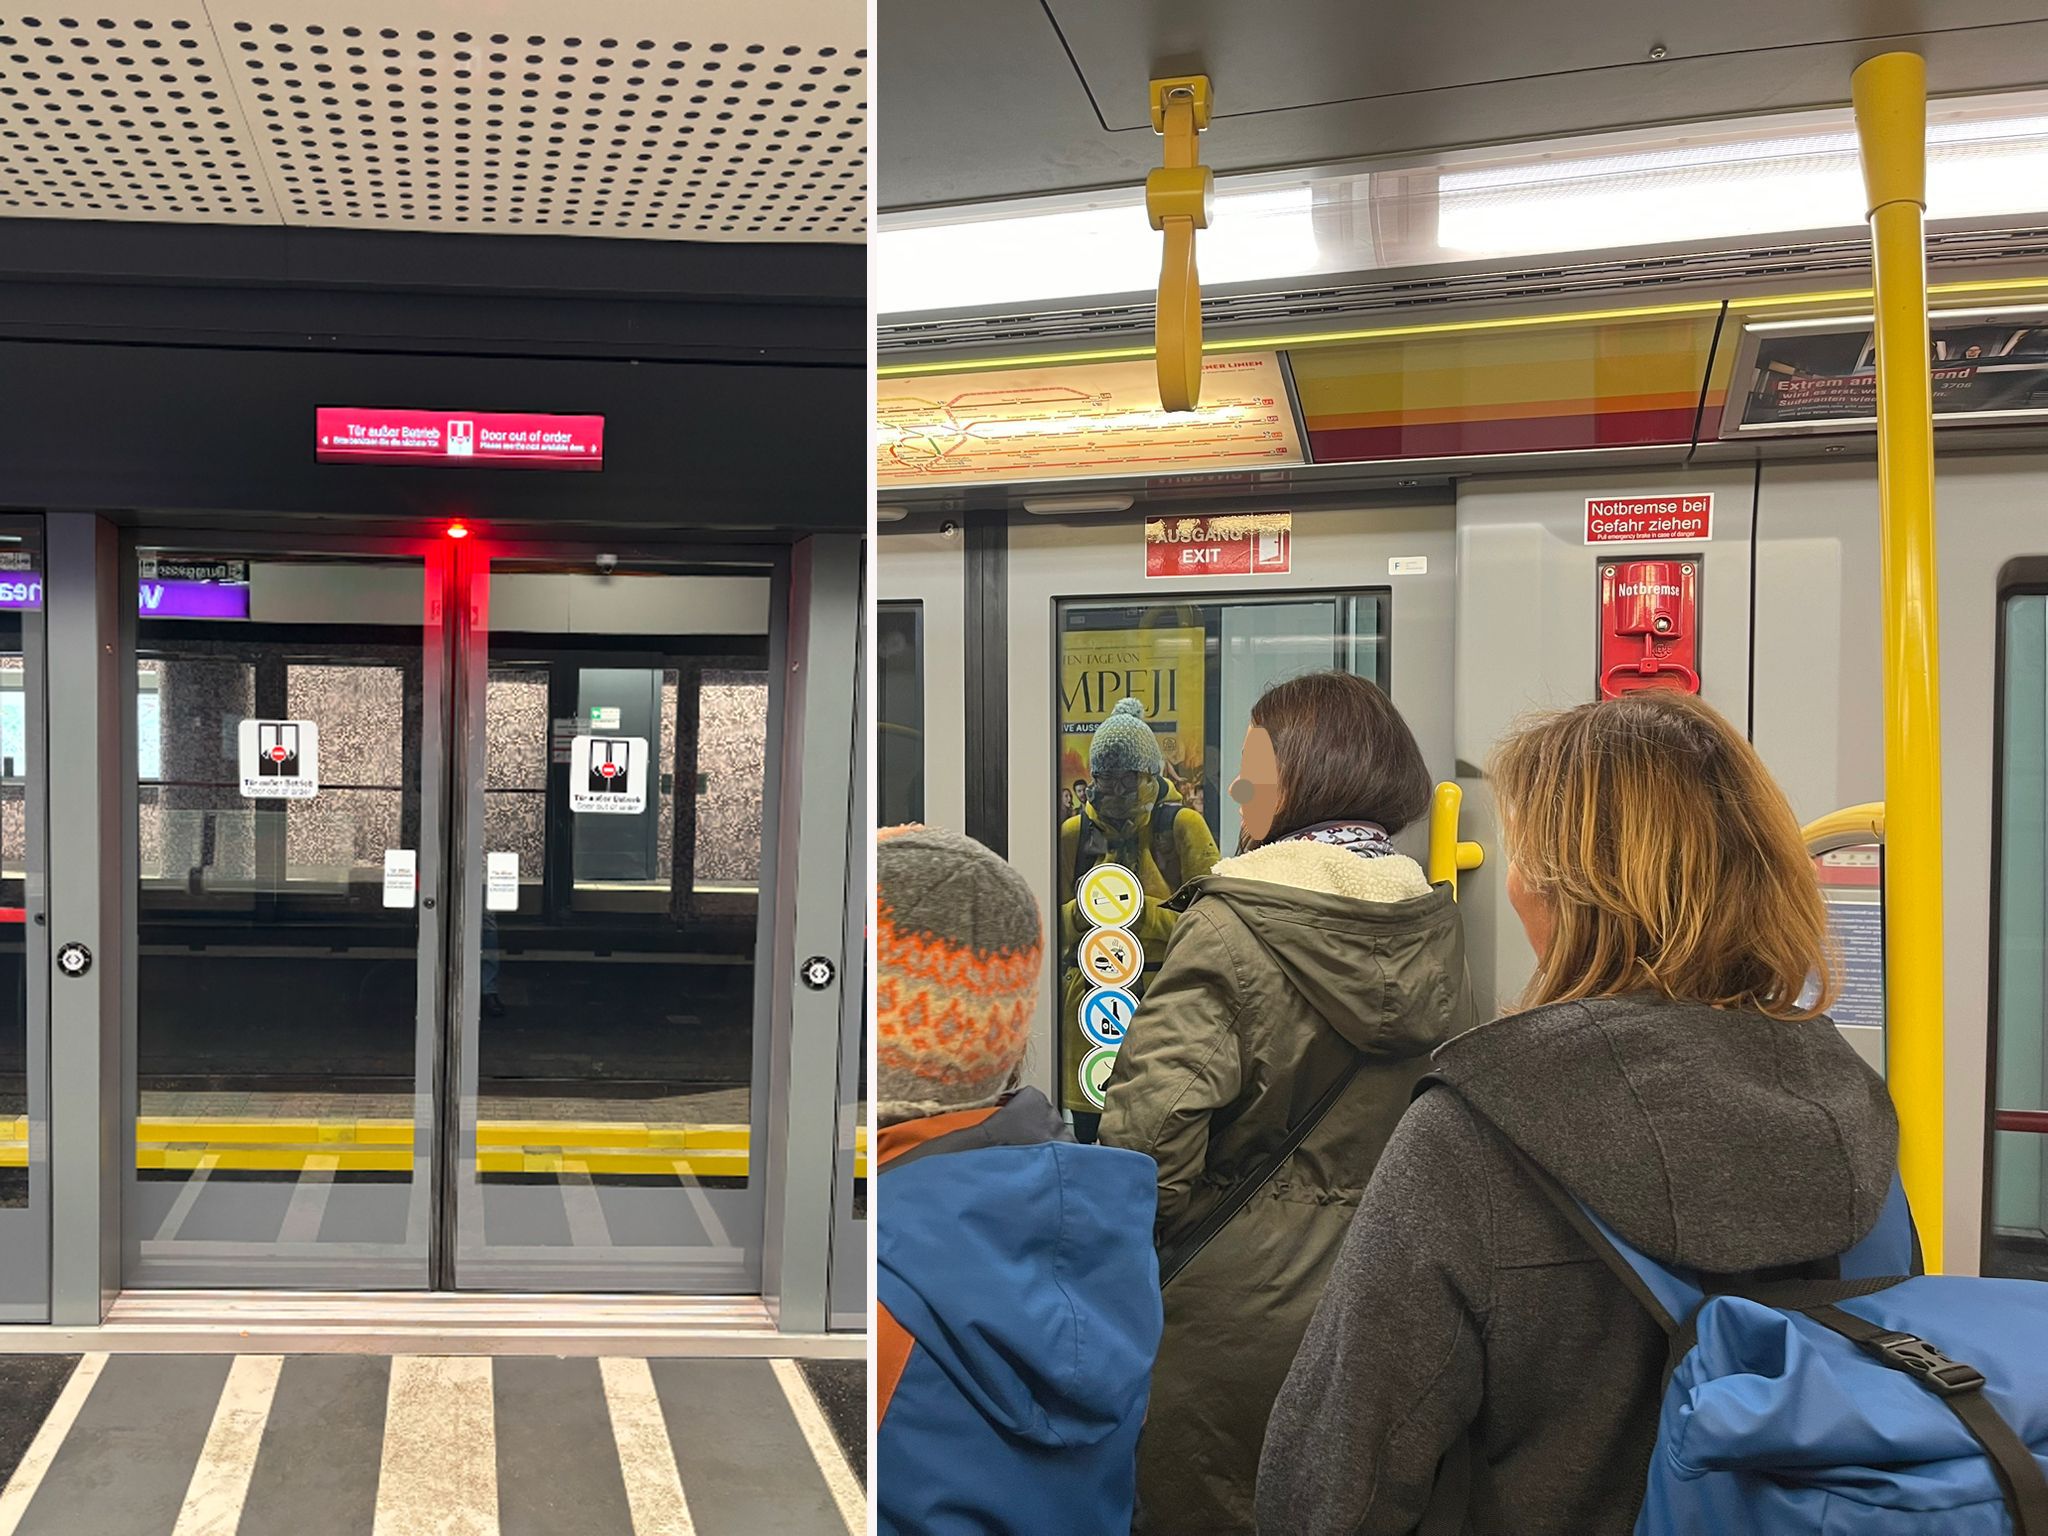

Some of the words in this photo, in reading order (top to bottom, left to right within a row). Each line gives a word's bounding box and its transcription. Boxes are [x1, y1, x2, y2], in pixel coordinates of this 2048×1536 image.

[1777, 379, 1842, 391] Extrem
[1782, 391, 1810, 399] wird
[347, 424, 366, 437] Tür
[481, 428, 507, 441] Door
[508, 430, 527, 442] out
[529, 430, 542, 442] of
[542, 431, 572, 443] order
[1591, 501, 1677, 516] Notbremse
[1683, 499, 1706, 512] bei
[1591, 518, 1644, 533] Gefahr
[1648, 517, 1701, 531] ziehen
[1608, 533, 1636, 541] emergency
[1182, 548, 1221, 564] EXIT
[1618, 581, 1680, 597] Notbremse
[1087, 654, 1113, 665] TAGE
[1117, 652, 1140, 664] VON
